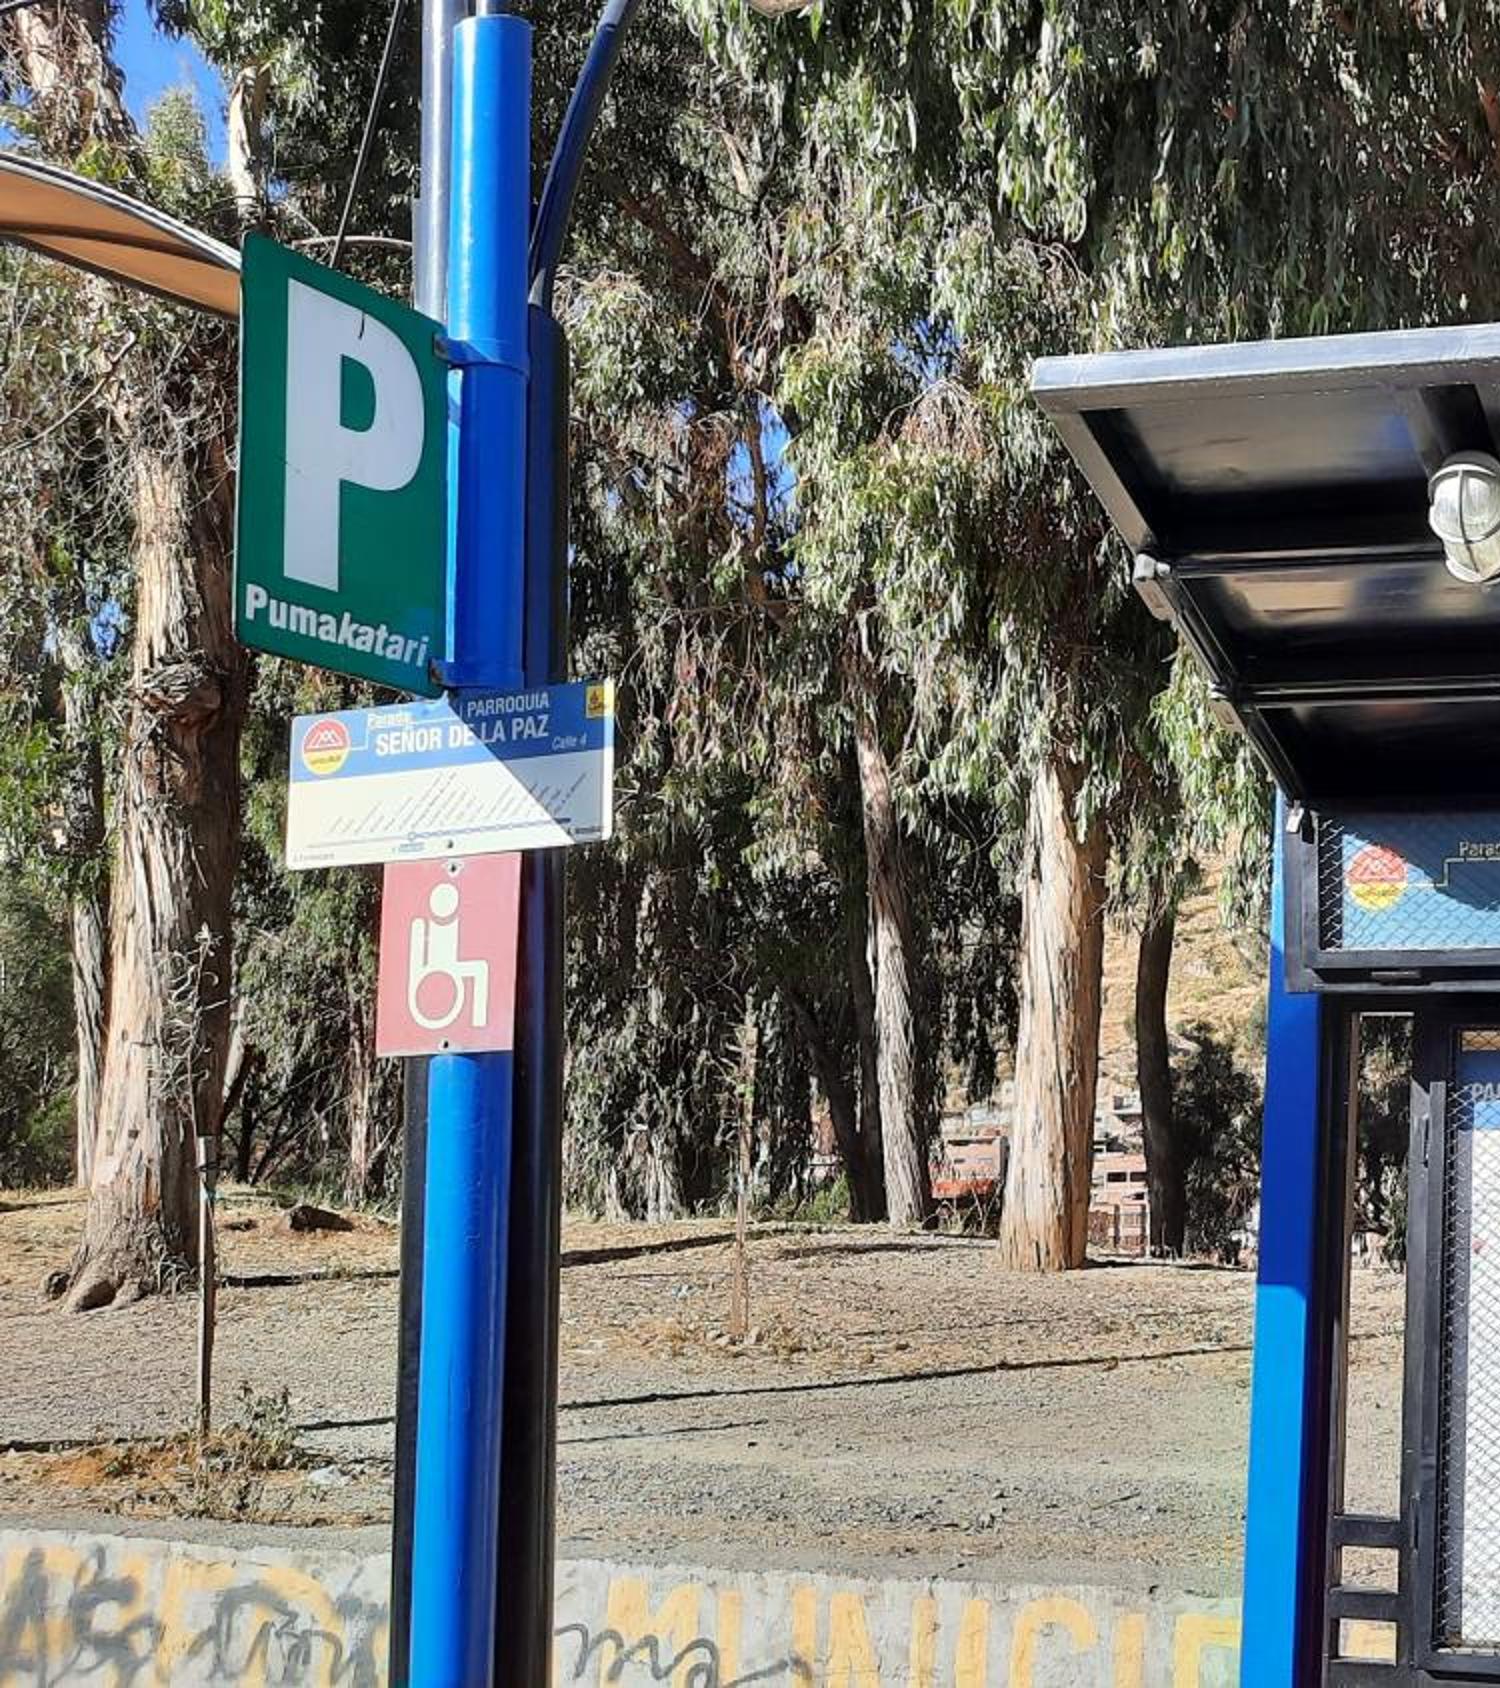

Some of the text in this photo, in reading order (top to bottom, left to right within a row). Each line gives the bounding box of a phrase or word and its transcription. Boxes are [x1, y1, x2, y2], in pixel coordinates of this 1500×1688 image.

[284, 278, 425, 592] P
[245, 583, 429, 667] Pumakatari
[448, 723, 476, 749] DE
[481, 718, 506, 743] LA
[511, 714, 549, 740] PAZ
[467, 691, 549, 718] PARROQUIA
